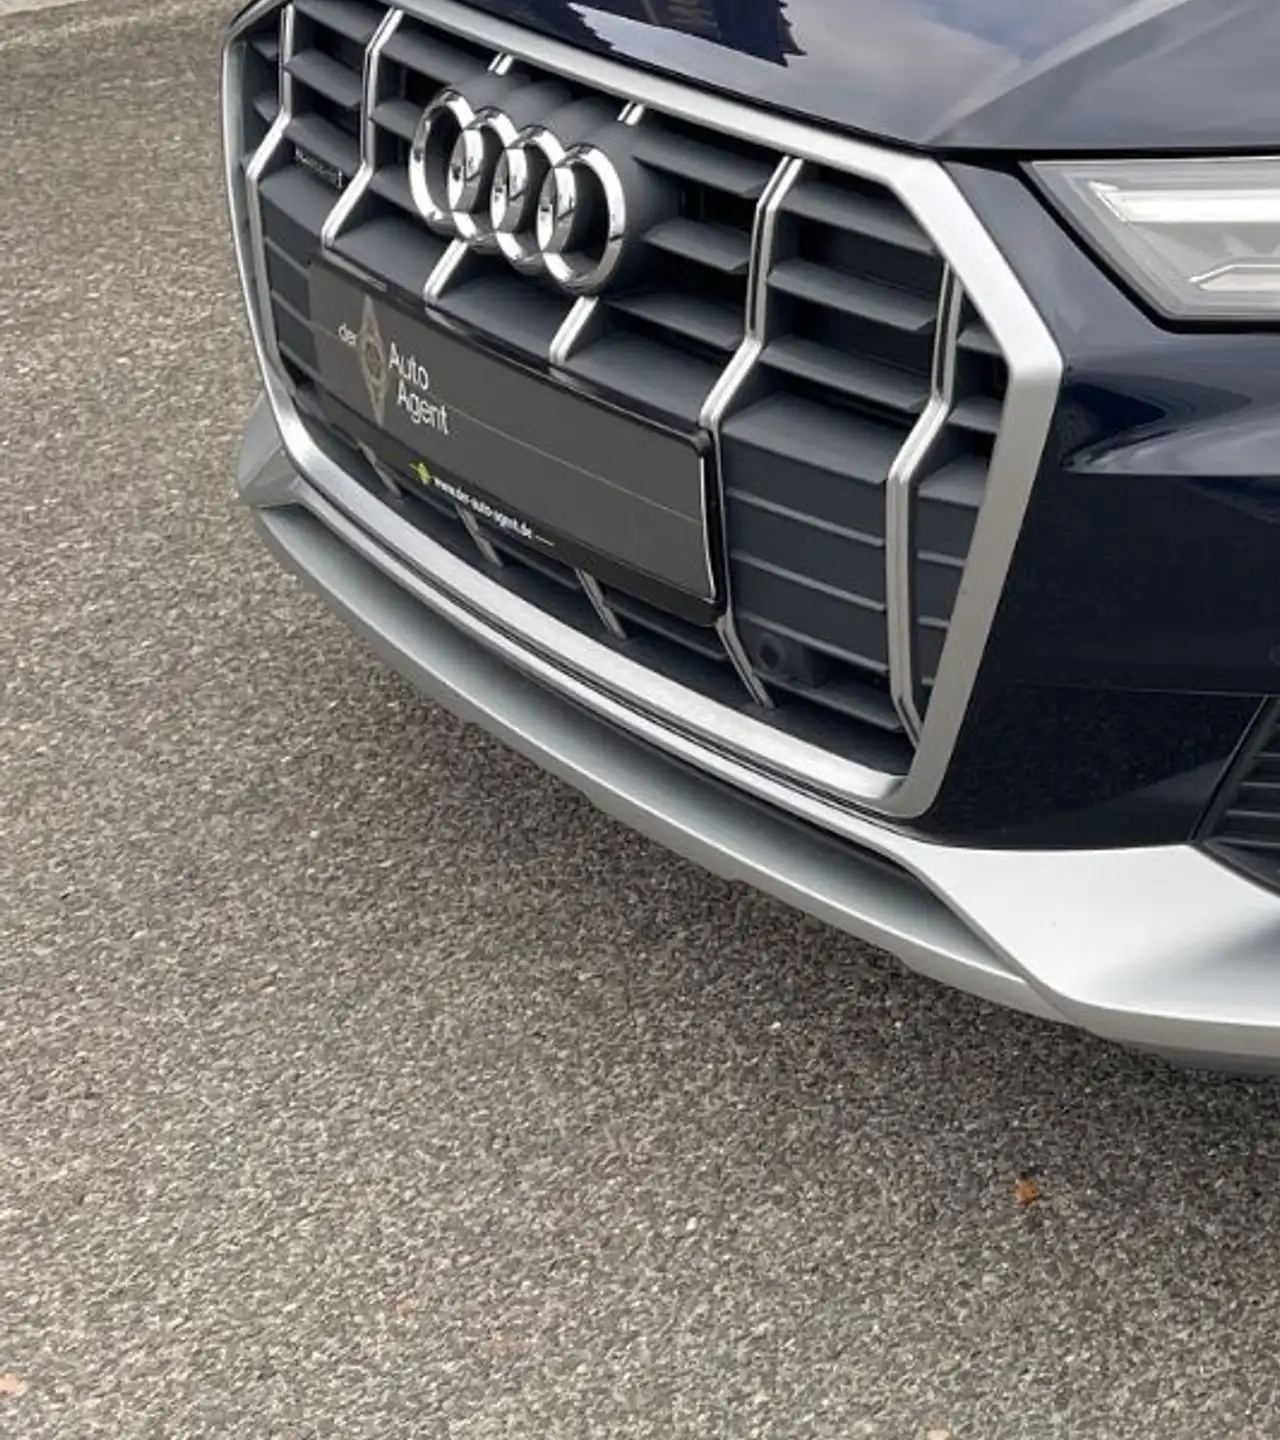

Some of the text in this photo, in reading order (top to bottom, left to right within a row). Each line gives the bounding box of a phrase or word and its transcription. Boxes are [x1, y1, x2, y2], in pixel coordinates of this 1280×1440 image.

[337, 323, 357, 346] der
[388, 341, 430, 392] Auto
[395, 377, 450, 436] Agent
